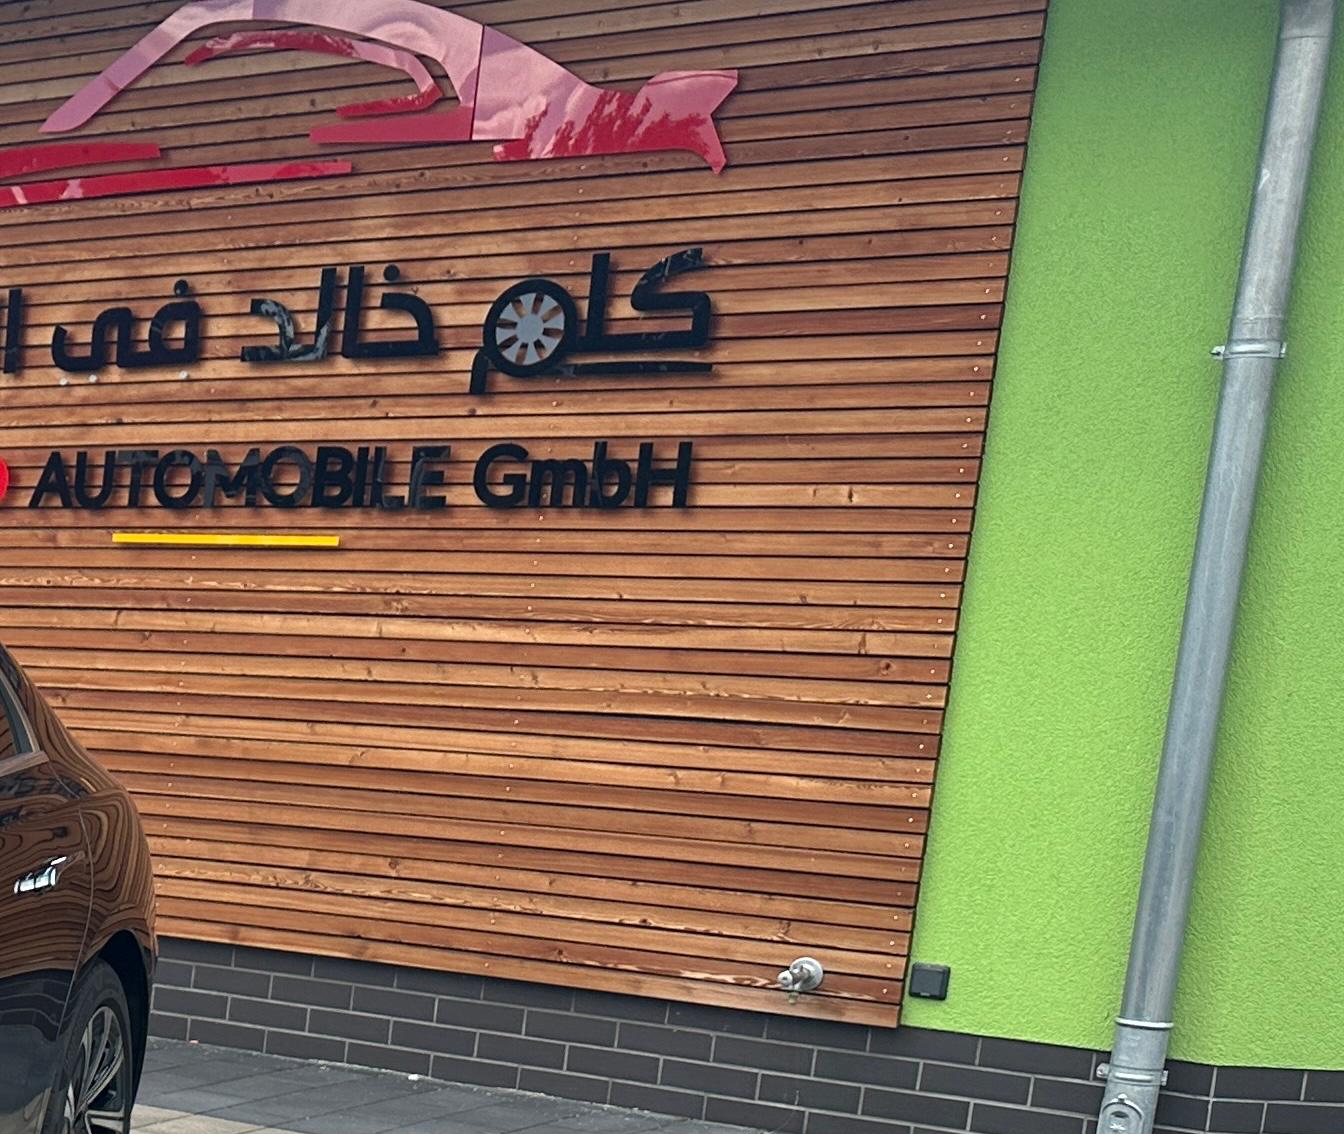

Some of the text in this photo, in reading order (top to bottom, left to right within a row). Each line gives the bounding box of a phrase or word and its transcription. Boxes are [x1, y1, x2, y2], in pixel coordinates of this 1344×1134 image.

[240, 264, 440, 361] خالد
[28, 445, 451, 510] AUTOMOBILE
[472, 441, 694, 509] GmbH
